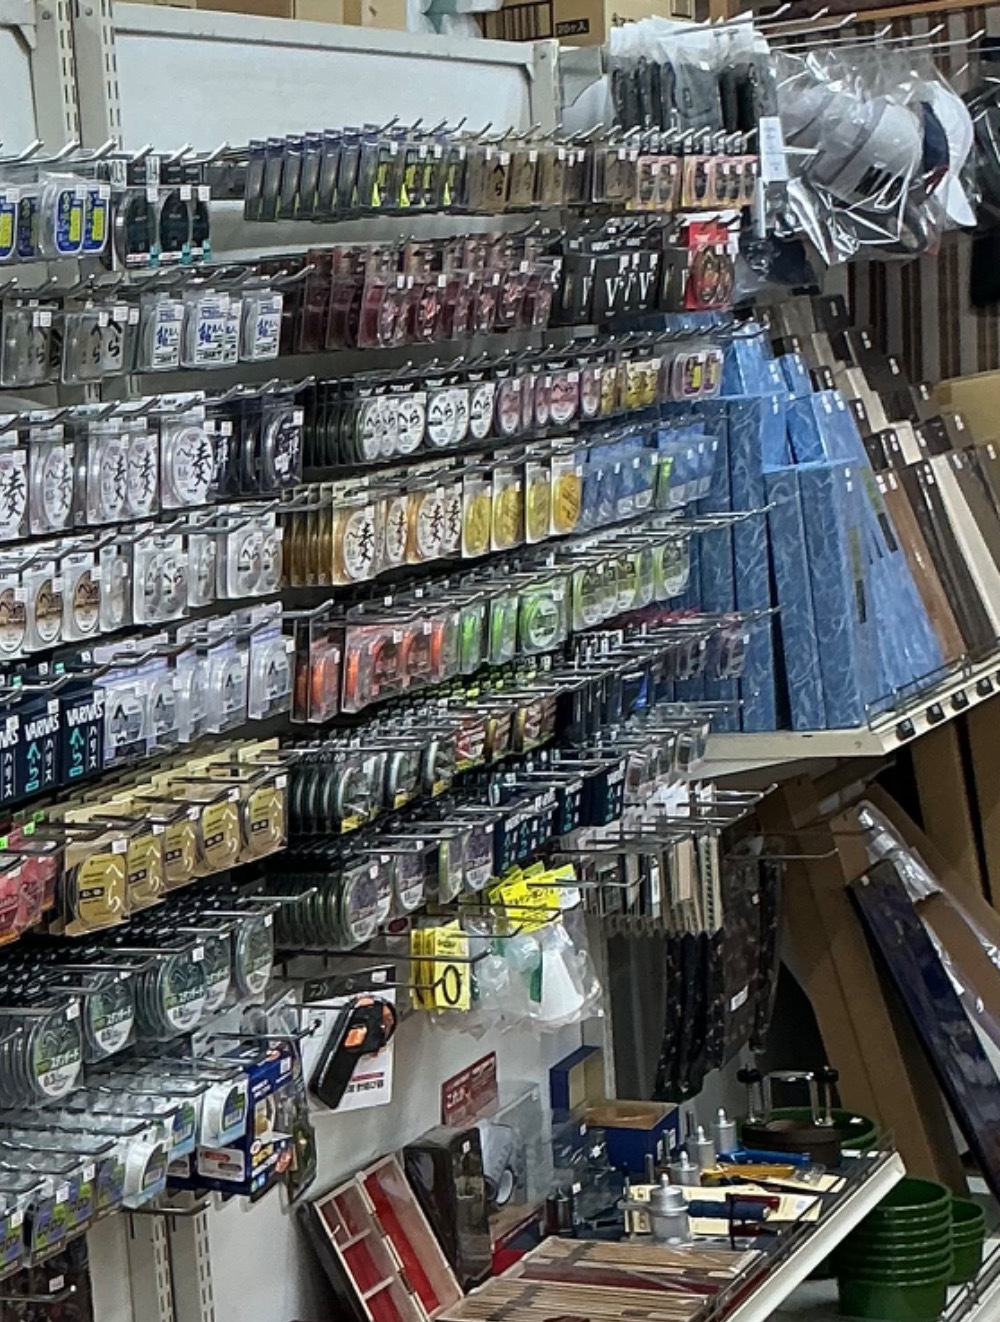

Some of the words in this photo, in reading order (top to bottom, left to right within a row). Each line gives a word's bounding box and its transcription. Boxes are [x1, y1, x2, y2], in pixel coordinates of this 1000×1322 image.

[26, 742, 41, 783] へら
[44, 738, 54, 783] ハリス
[69, 727, 85, 765] へら
[88, 725, 98, 769] ハリス
[3, 752, 13, 798] ハリス
[106, 863, 124, 913] へら
